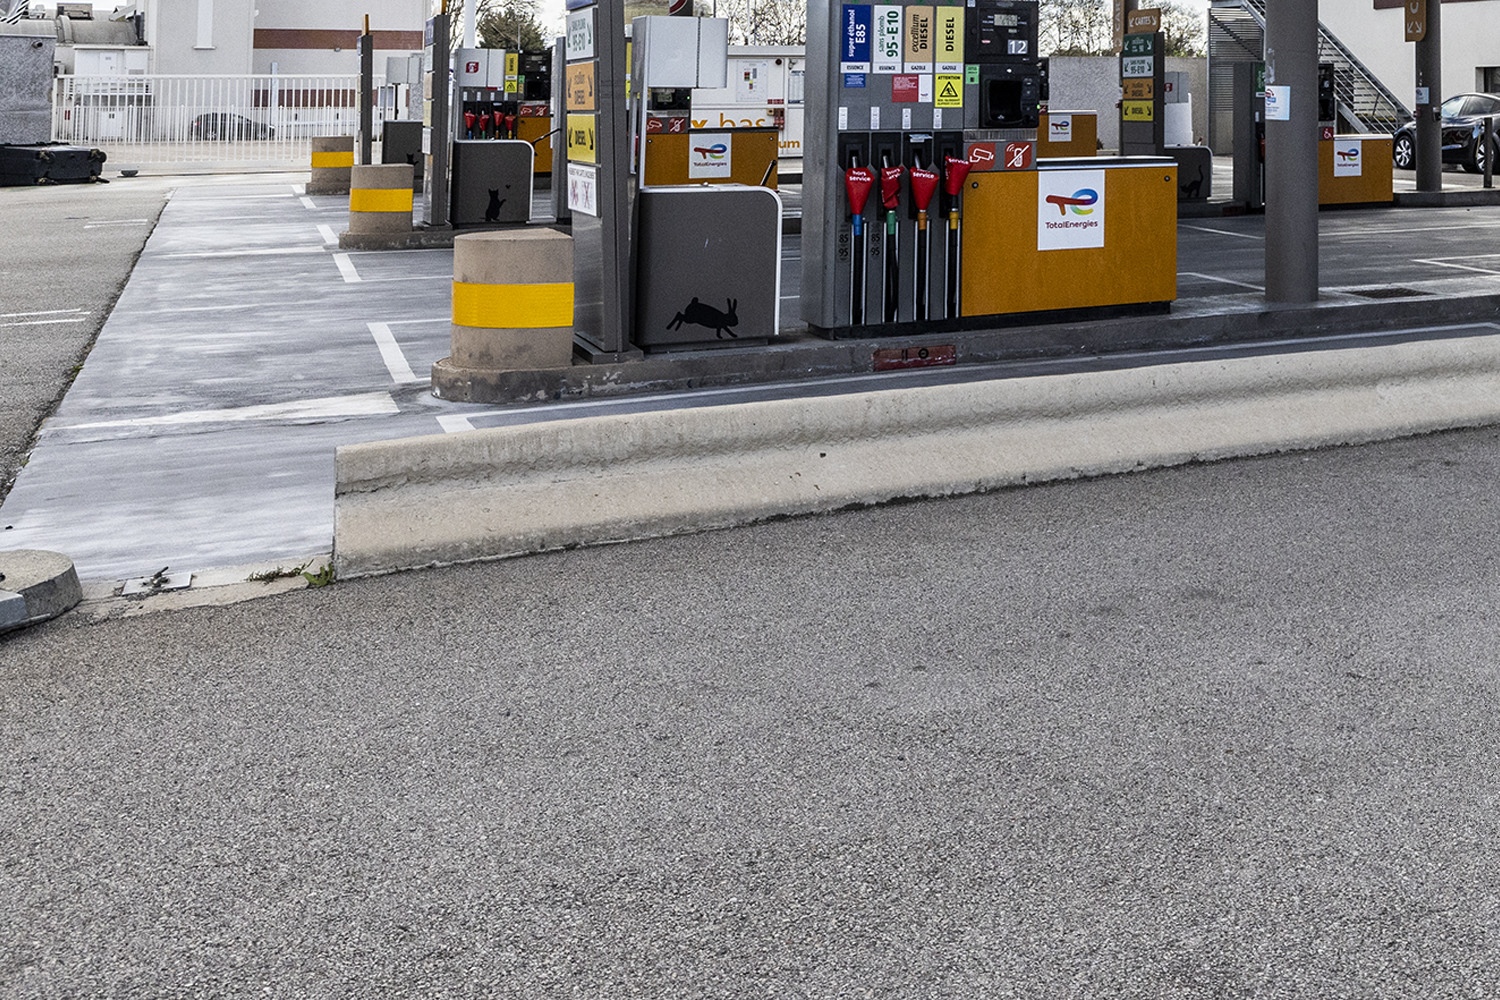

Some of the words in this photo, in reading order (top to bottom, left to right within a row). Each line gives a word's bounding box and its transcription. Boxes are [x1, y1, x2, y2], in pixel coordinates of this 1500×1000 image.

[1135, 17, 1151, 26] CARTES
[855, 23, 866, 44] E85
[886, 10, 899, 57] 95-E10
[911, 14, 920, 53] excellium
[920, 17, 928, 49] DIESEL
[945, 17, 955, 51] DIESEL
[848, 38, 856, 57] super
[1009, 40, 1027, 54] 12
[1045, 220, 1099, 229] TotalEnergies
[839, 233, 849, 243] 85
[871, 233, 880, 243] 85
[838, 247, 849, 257] 95
[870, 247, 880, 256] 95
